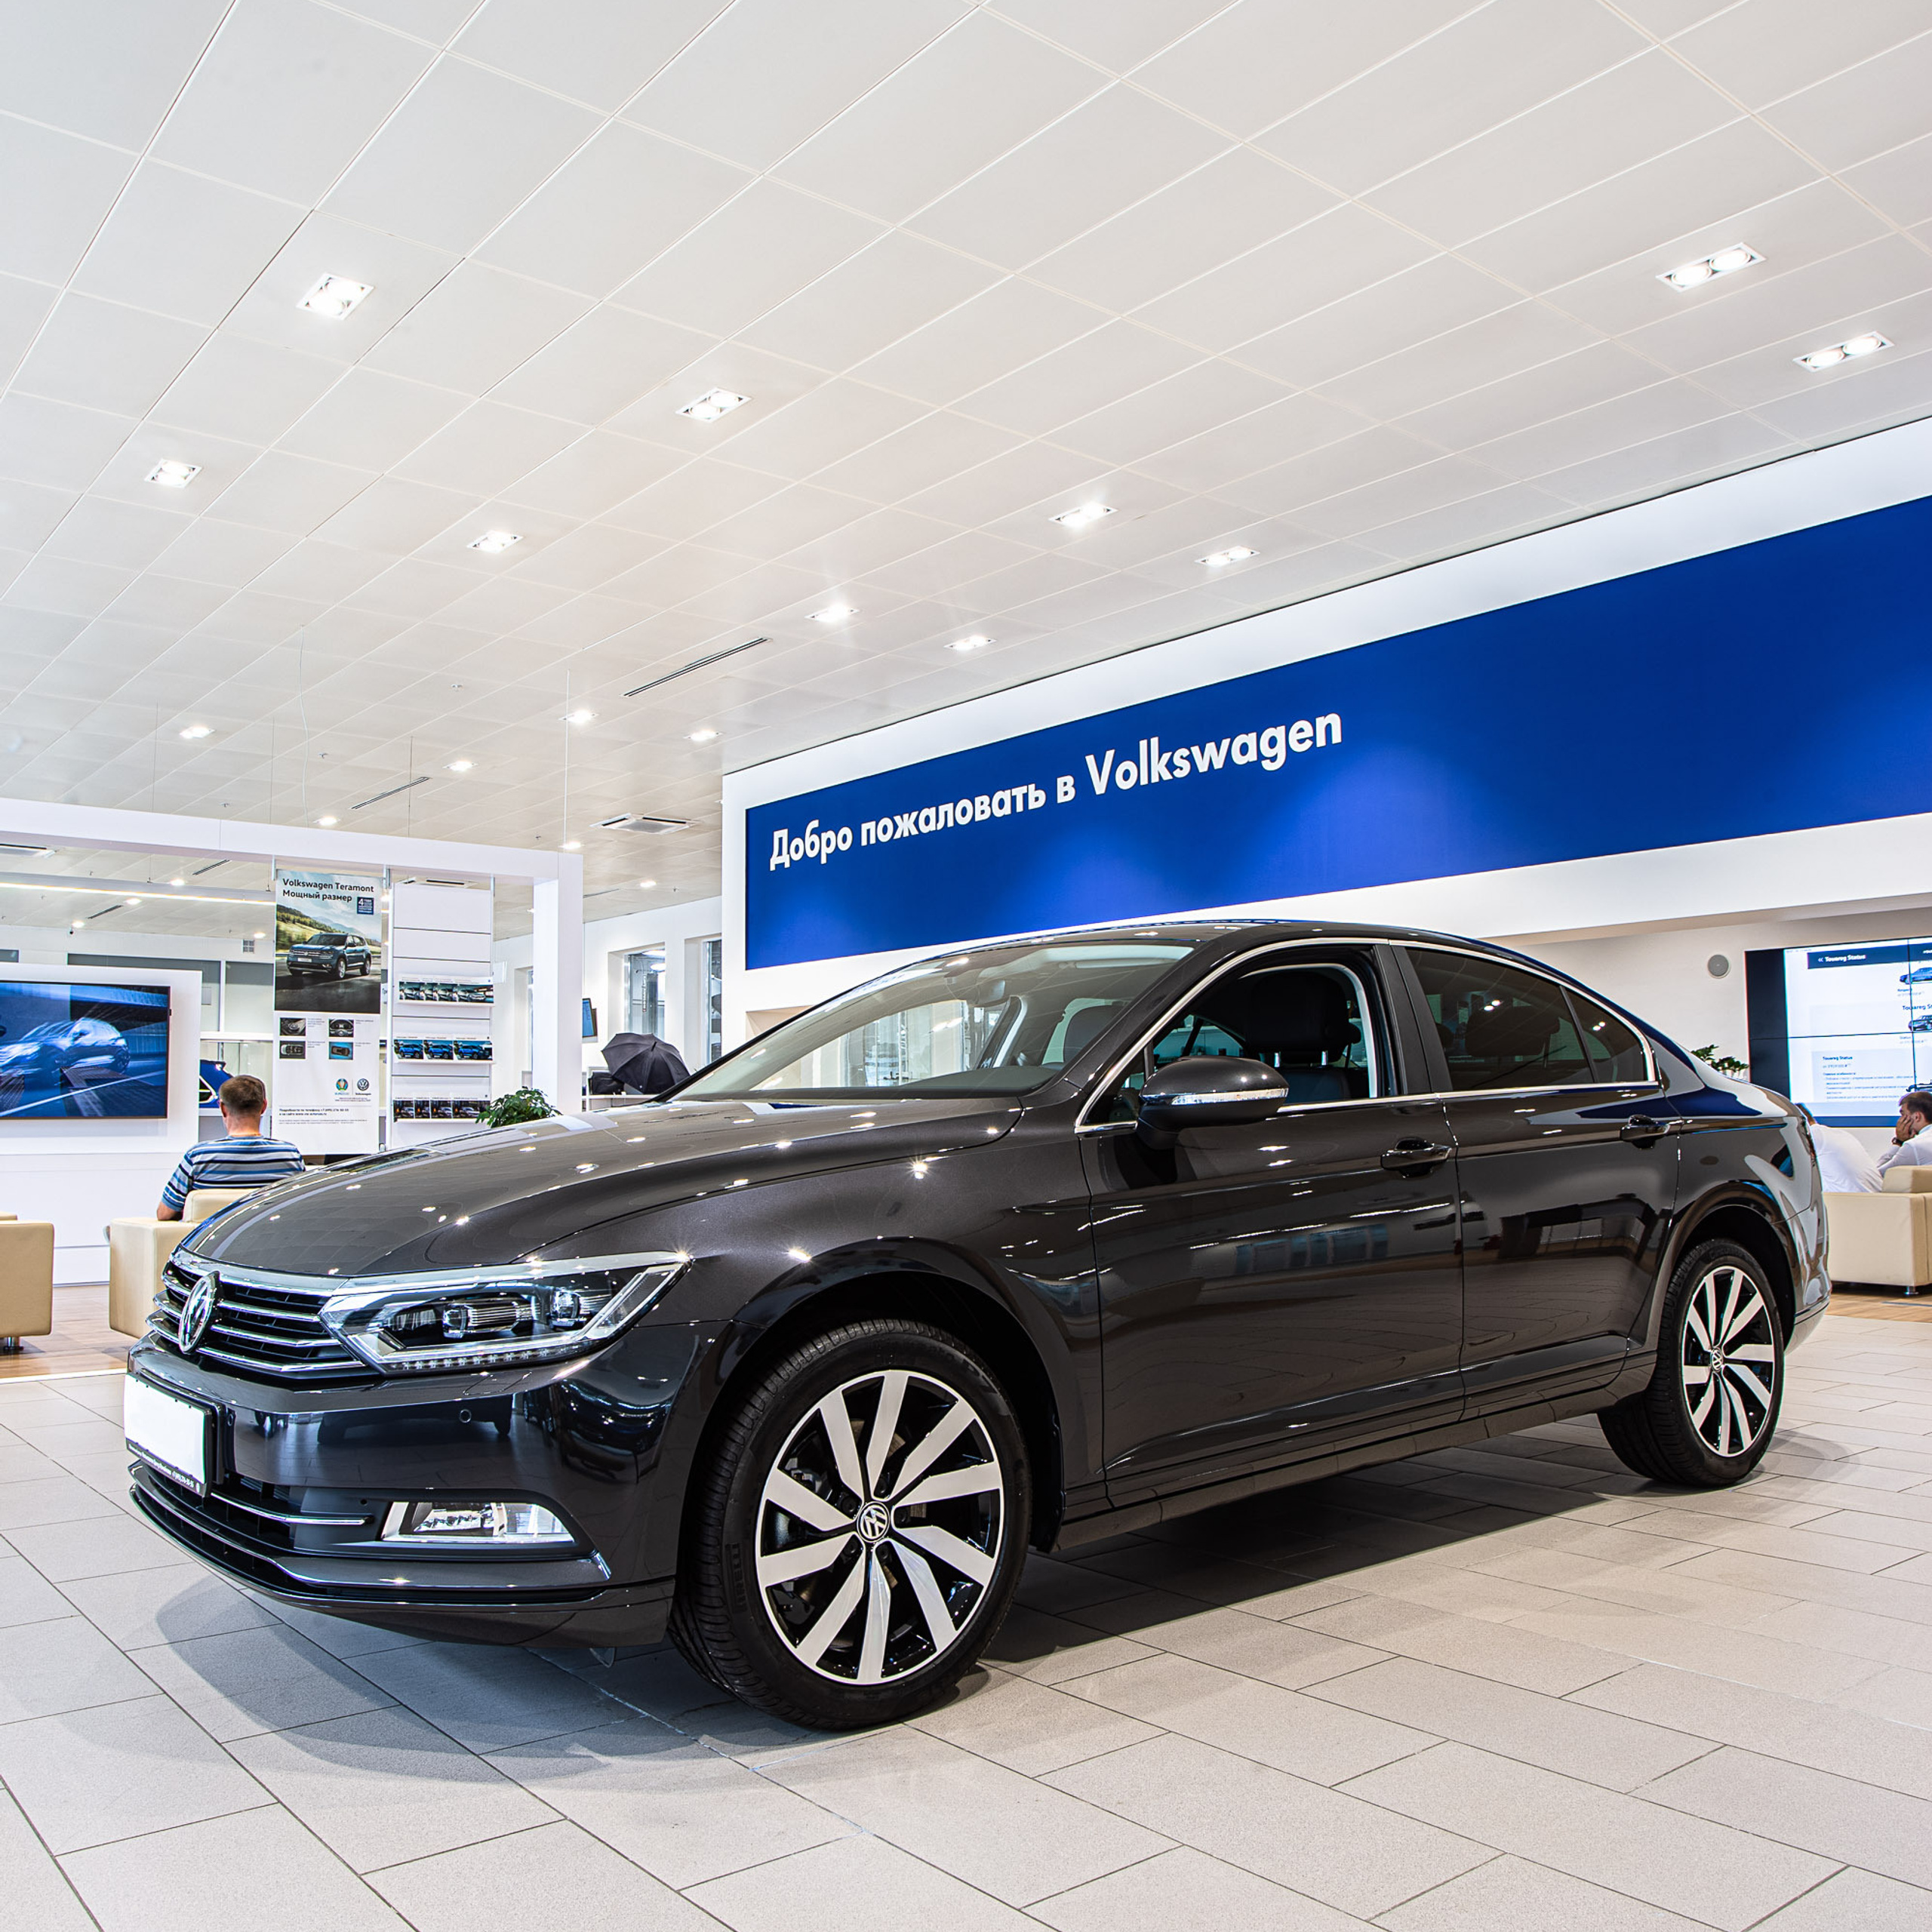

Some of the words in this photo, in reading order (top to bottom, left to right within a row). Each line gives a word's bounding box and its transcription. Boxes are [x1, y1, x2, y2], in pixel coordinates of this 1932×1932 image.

[770, 819, 854, 872] Добро
[860, 783, 1047, 846] пожаловать
[1057, 775, 1076, 804] в
[1084, 712, 1343, 795] Volkswagen
[282, 878, 334, 890] Volkswagen
[335, 882, 374, 892] Teramont
[282, 890, 320, 900] Мощный
[322, 893, 352, 903] размер
